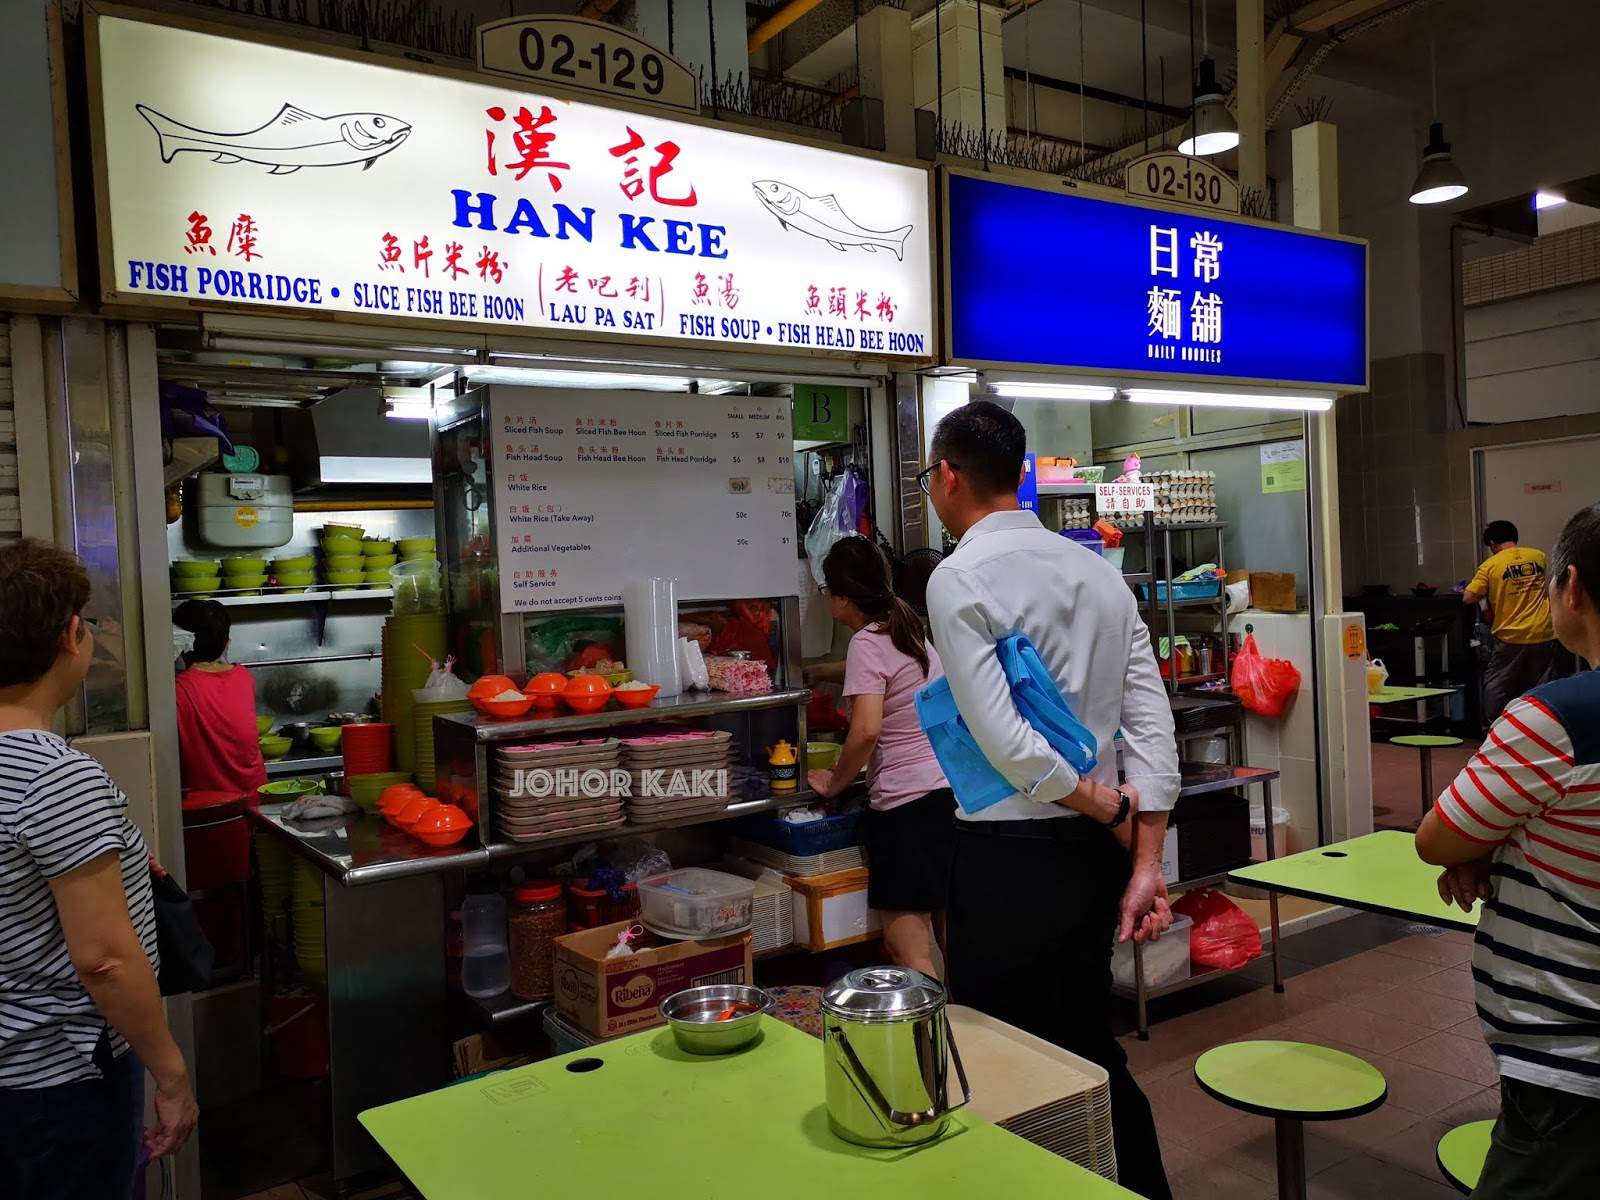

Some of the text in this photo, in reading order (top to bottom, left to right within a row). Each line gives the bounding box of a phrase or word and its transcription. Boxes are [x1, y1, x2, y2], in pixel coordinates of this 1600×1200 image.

[519, 27, 664, 95] 02-129
[485, 105, 697, 207] 漢記
[1146, 162, 1221, 205] 02-130
[451, 189, 729, 260] HAN KEE
[377, 231, 509, 284] 魚片米粉
[1150, 224, 1223, 283] 日常
[128, 260, 322, 304] FISH PORRIDGE
[692, 271, 740, 310] 魚湯
[353, 283, 524, 321] SLICE FISH BEE HOON
[804, 284, 897, 322] 魚頭米粉
[550, 303, 655, 330] LAU PA SAT
[680, 313, 760, 340] FISH SOUP
[778, 322, 924, 353] FISH HEAD BEE HOON
[1148, 344, 1221, 363] DAILY NOODLES
[811, 391, 832, 424] B
[504, 426, 527, 434] Sliced
[545, 427, 564, 436] Soup
[575, 427, 597, 435] Sliced
[614, 428, 627, 436] Bee
[690, 431, 717, 439] Porridge
[731, 431, 740, 439] $5
[777, 432, 785, 440] $9
[506, 453, 563, 463] Fish Head Soup
[577, 454, 592, 462] Fish
[593, 454, 612, 462] Head
[656, 455, 717, 464] Fish Head Porridge
[757, 456, 765, 464] $8
[778, 456, 790, 464] $10
[508, 473, 528, 482] 白饭
[1099, 486, 1151, 496] SELF-SERVICES
[1105, 497, 1146, 510] 請自助
[509, 513, 594, 523] White Rice (Take Away)
[737, 538, 749, 546] 50c
[782, 536, 790, 544] $1
[511, 543, 591, 553] Additional Vegetables
[513, 569, 558, 579] 自助服务
[513, 580, 556, 588] Self Service
[514, 599, 527, 607] We
[529, 598, 539, 606] do
[554, 596, 577, 605] accept
[584, 595, 603, 603] cents
[615, 984, 652, 1003] Ribena
